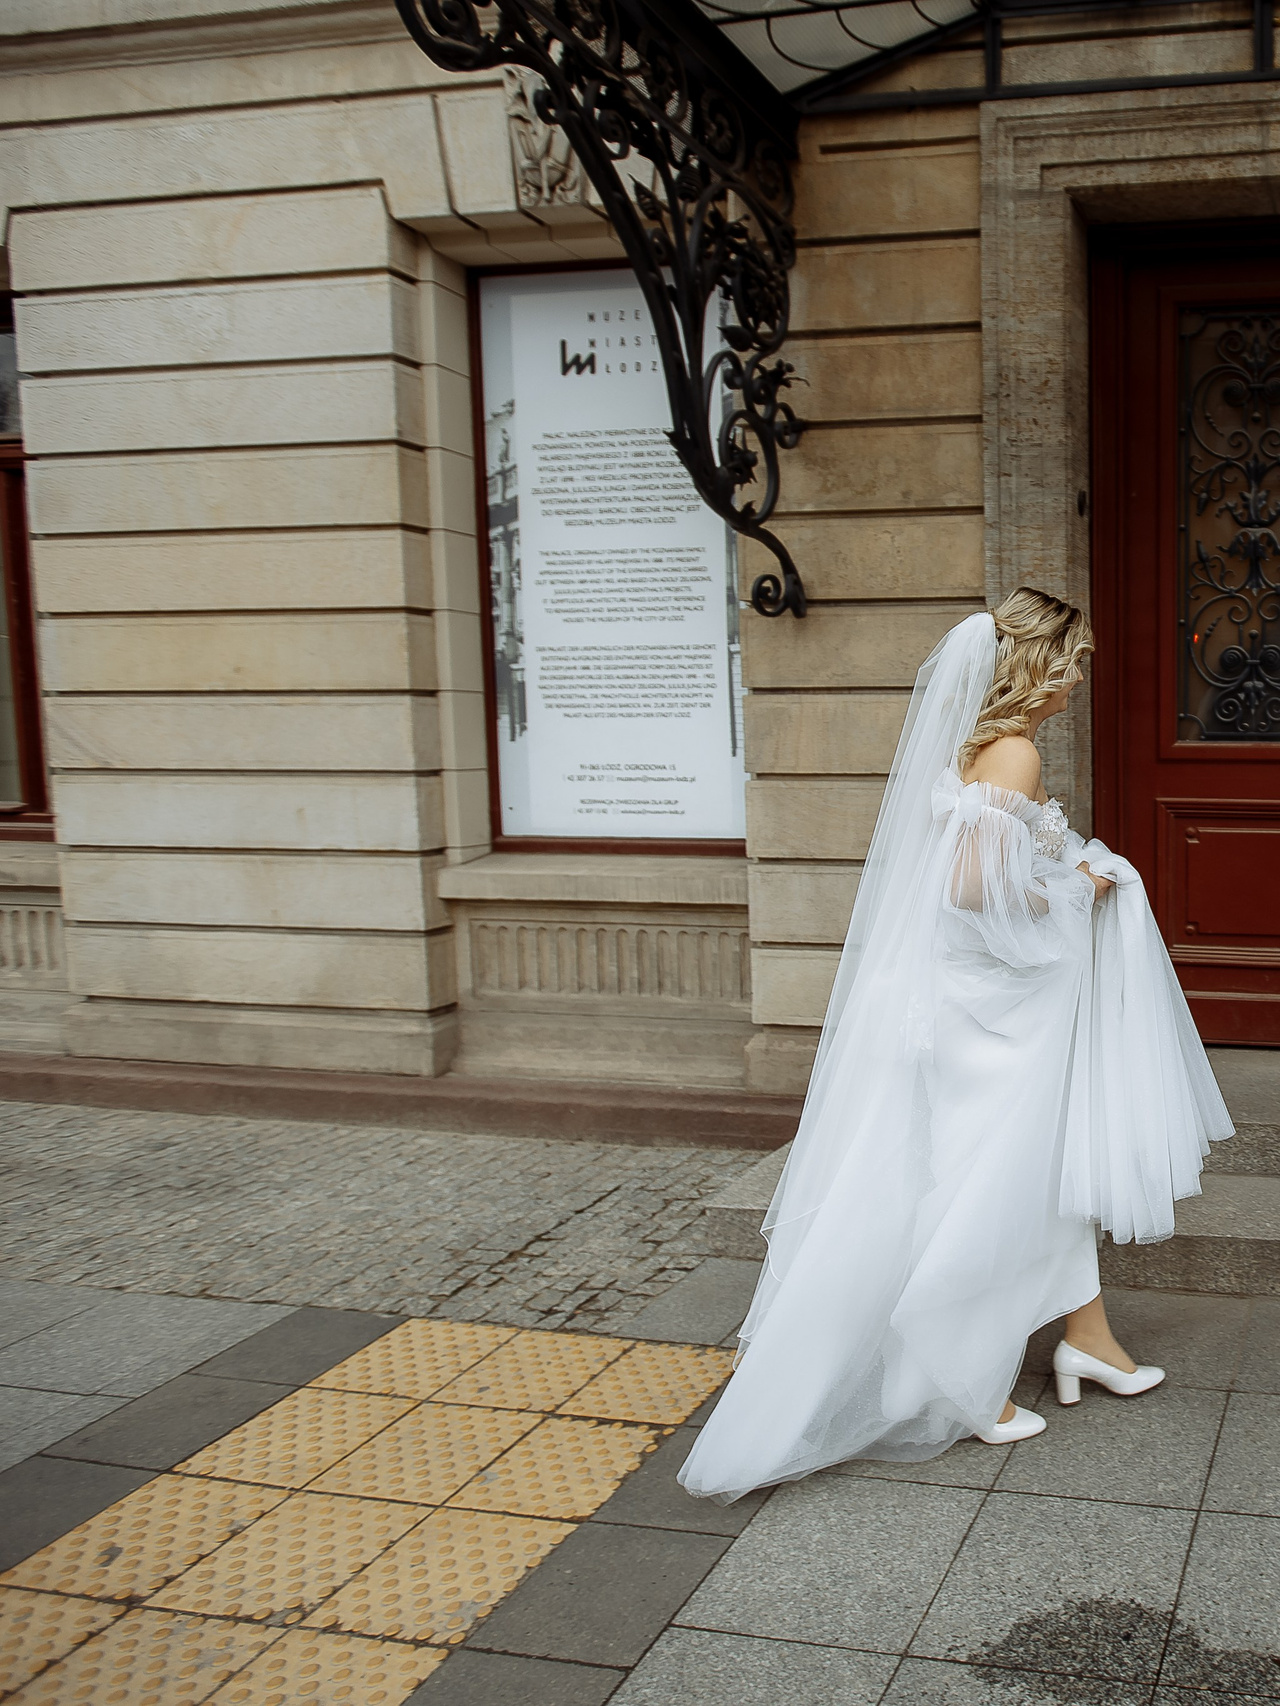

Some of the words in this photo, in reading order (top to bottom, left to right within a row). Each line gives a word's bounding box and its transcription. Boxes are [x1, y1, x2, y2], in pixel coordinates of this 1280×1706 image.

[586, 309, 641, 323] MUZE
[587, 334, 656, 348] MIAST
[605, 360, 657, 374] ŁODZ
